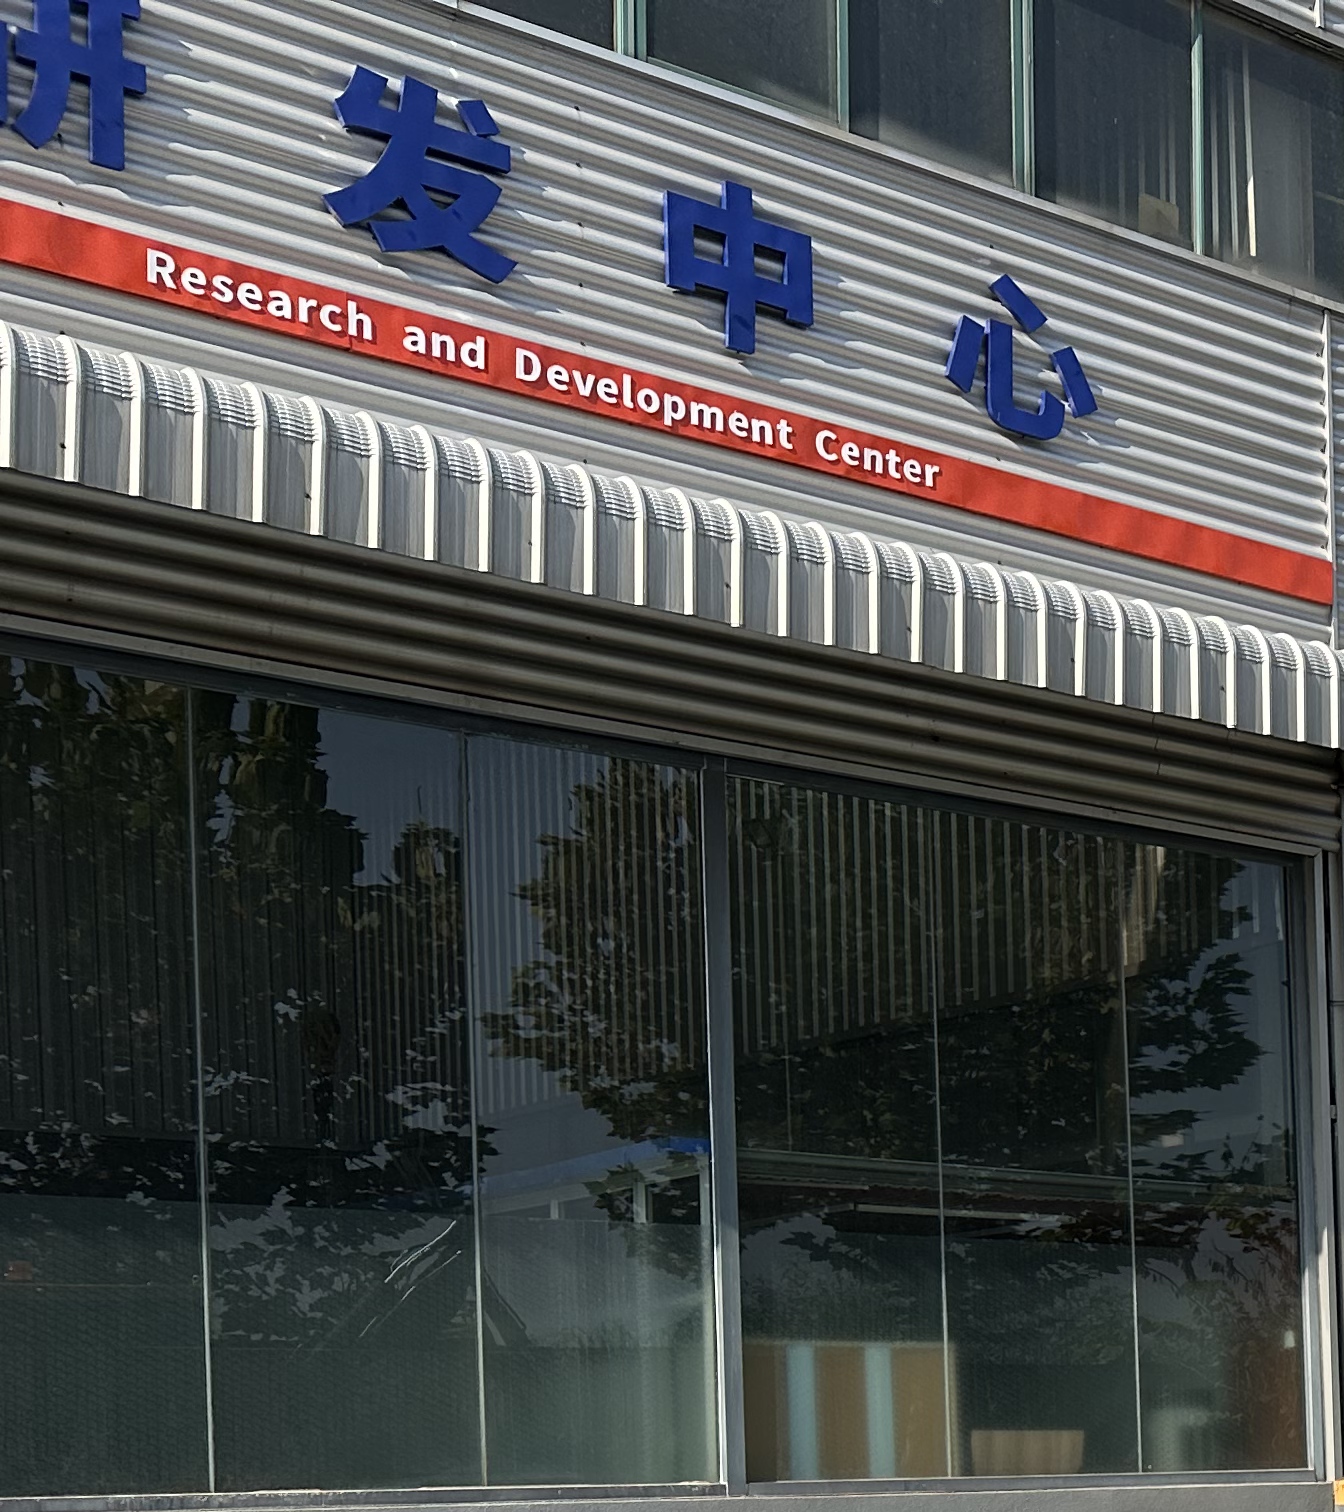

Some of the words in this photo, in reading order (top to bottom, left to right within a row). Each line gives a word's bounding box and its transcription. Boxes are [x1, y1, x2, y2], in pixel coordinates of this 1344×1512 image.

[146, 247, 373, 341] Research
[402, 326, 485, 370] and
[515, 347, 793, 450] Development
[814, 429, 941, 487] Center
